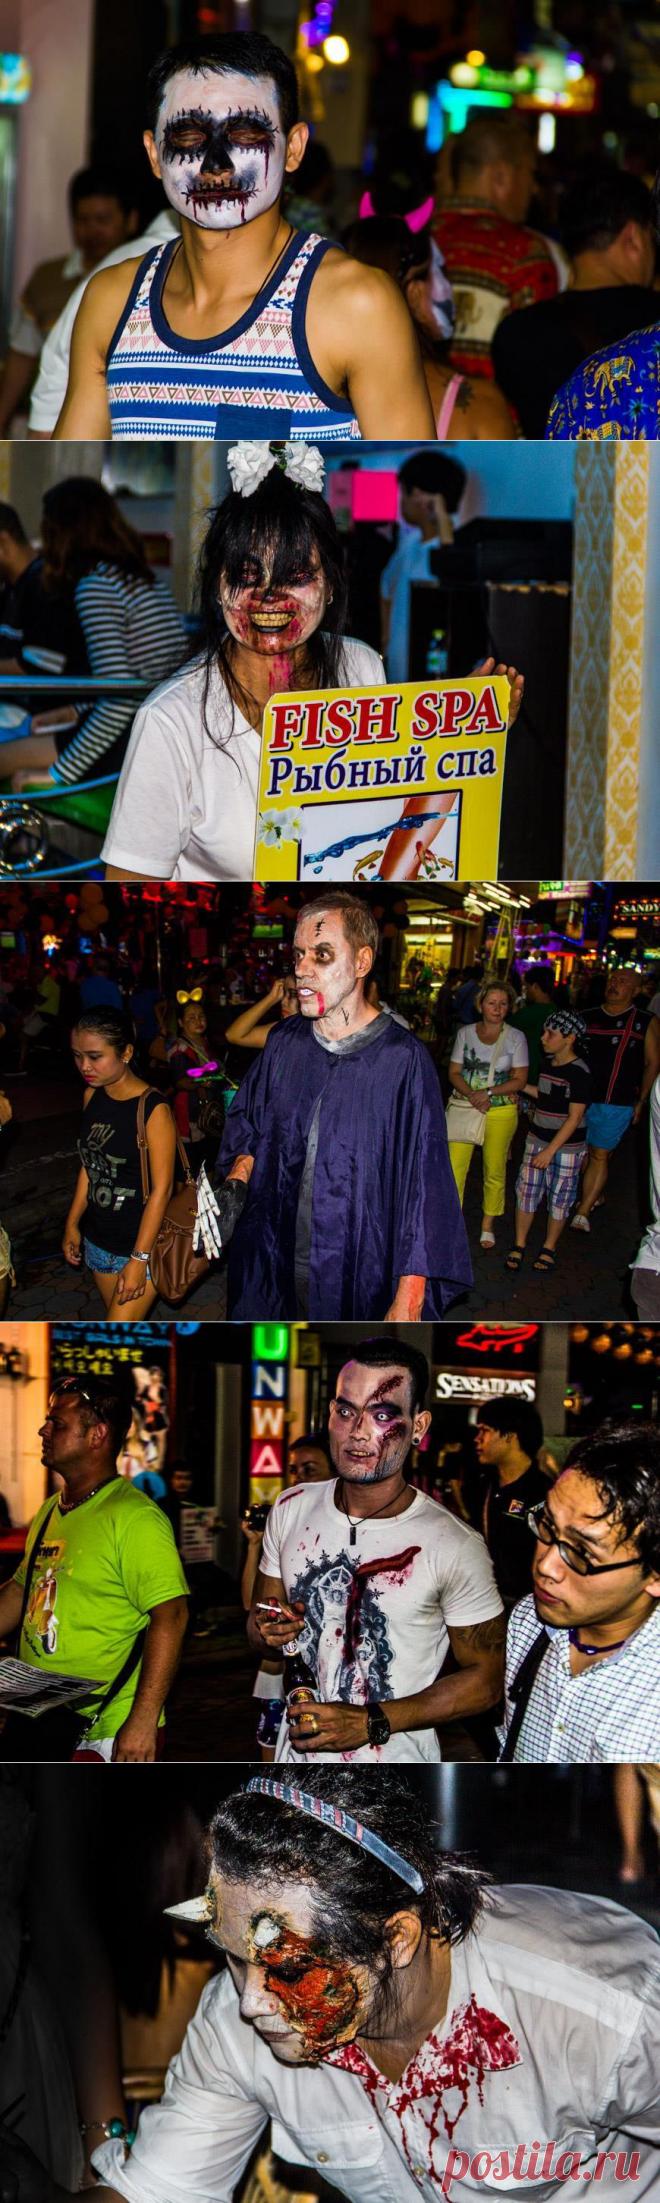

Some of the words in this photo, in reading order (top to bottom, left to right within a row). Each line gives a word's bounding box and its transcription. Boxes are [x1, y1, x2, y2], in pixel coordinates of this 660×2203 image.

[269, 695, 401, 752] FISH
[411, 686, 506, 740] SPA
[267, 746, 427, 796] Рыбный
[437, 748, 497, 780] спа
